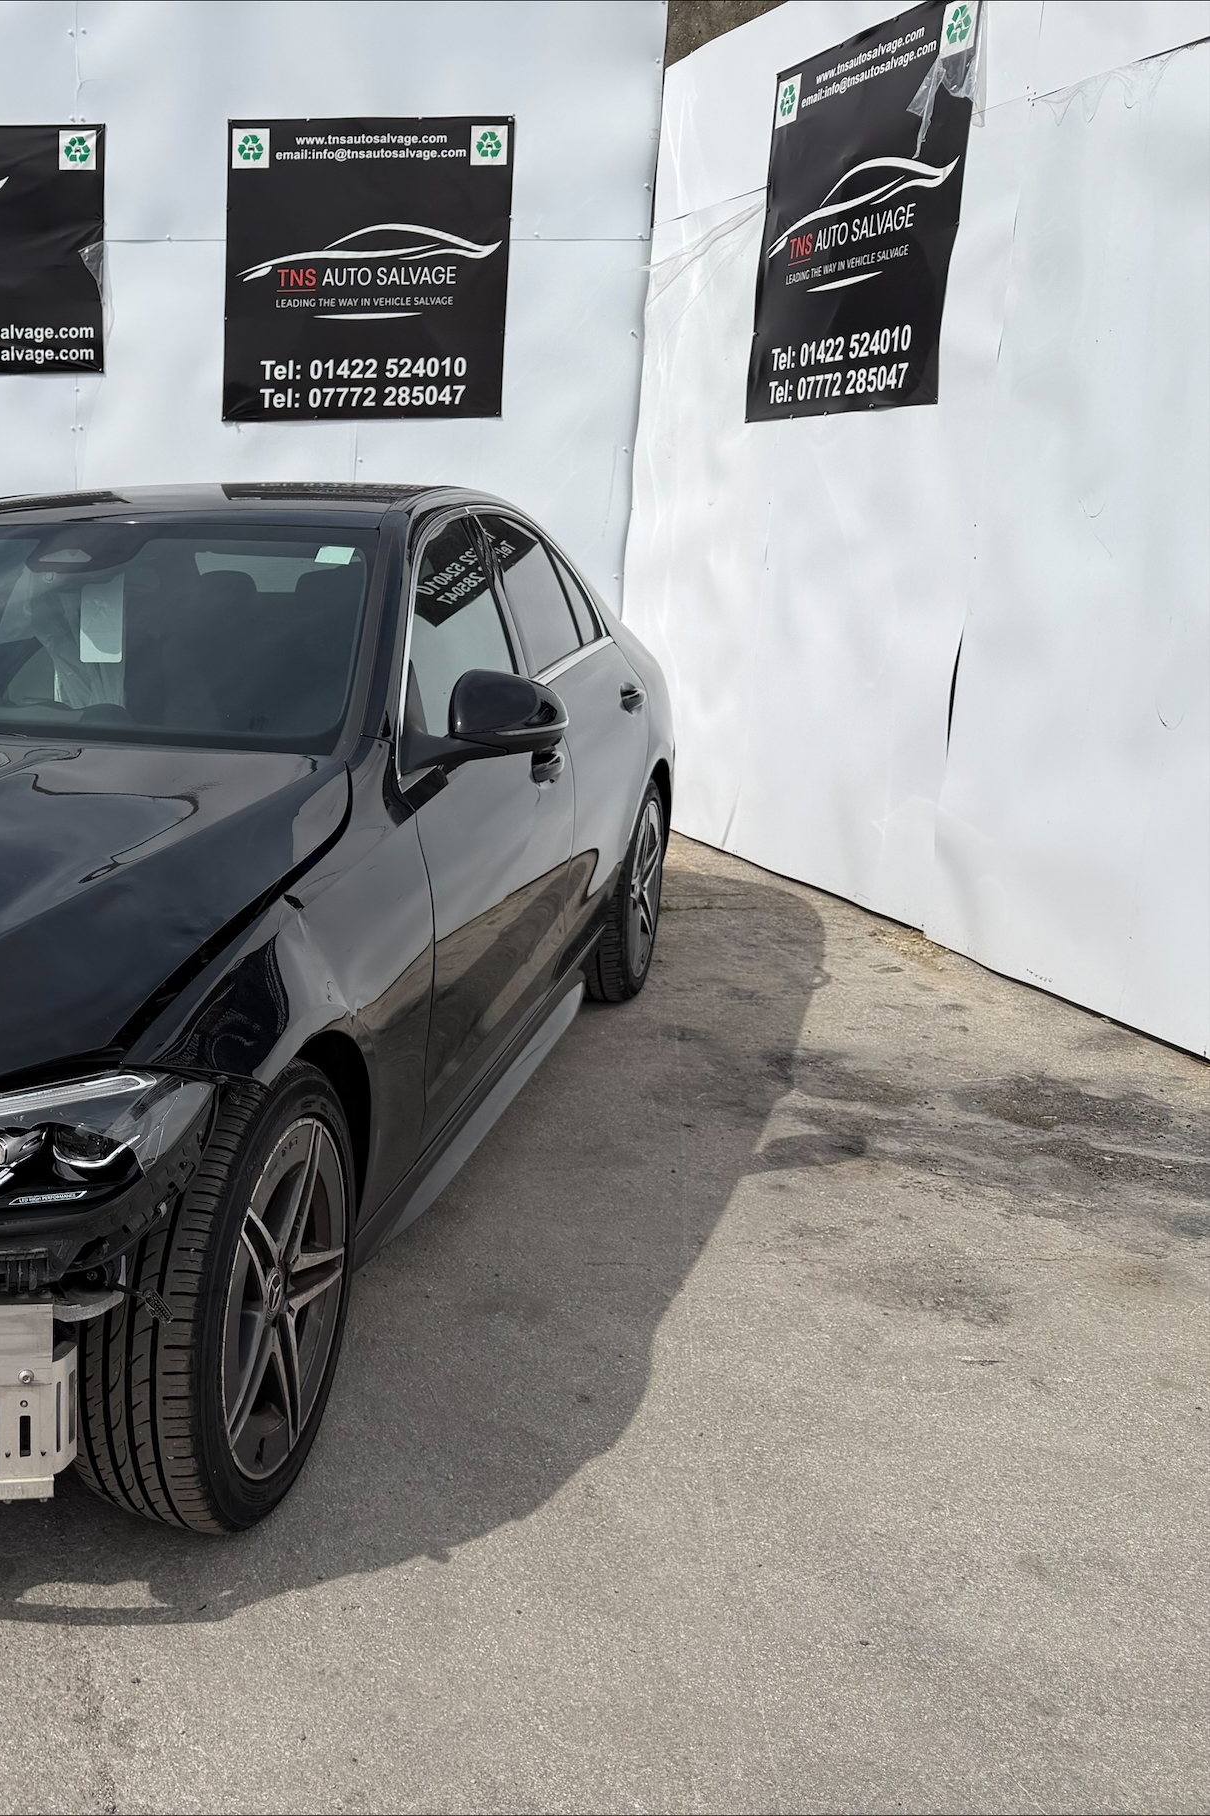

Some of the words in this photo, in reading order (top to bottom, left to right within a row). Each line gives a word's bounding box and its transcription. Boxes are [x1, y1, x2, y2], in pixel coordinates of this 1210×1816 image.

[816, 27, 925, 85] www.tnsautosalvage.com
[801, 39, 937, 108] email:info@tnsautosalvage.com
[276, 148, 466, 162] email:info@tnsautosalvage.com
[295, 133, 447, 146] www.tnsautosalvage.com
[790, 233, 813, 259] TNS
[814, 222, 848, 252] AUTO
[851, 203, 916, 242] SALVAGE
[277, 268, 316, 287] TNS
[322, 267, 372, 286] AUTO
[376, 266, 457, 285] SALVAGE
[786, 270, 810, 285] LEADING
[811, 266, 822, 278] THE
[823, 262, 837, 274] WAY
[838, 260, 845, 271] IN
[847, 252, 876, 268] VEHICLE
[877, 244, 909, 262] SALVAGE
[276, 298, 316, 308] LEADING
[318, 298, 336, 307] THE
[338, 298, 358, 306] WAY
[361, 298, 370, 306] IN
[373, 297, 411, 306] VEHICLE
[414, 296, 453, 305] SALVAGE
[771, 346, 796, 371] Tel:
[800, 336, 844, 367] 01422
[849, 324, 911, 359] 524010
[260, 360, 301, 380] Tel:
[310, 358, 377, 380] 01422
[385, 357, 467, 378] 524010
[769, 379, 793, 404] Tel:
[797, 372, 842, 401] 07772
[845, 362, 909, 395] 285047
[260, 388, 300, 408] Tel:
[309, 387, 376, 408] 07772
[383, 385, 466, 406] 285047
